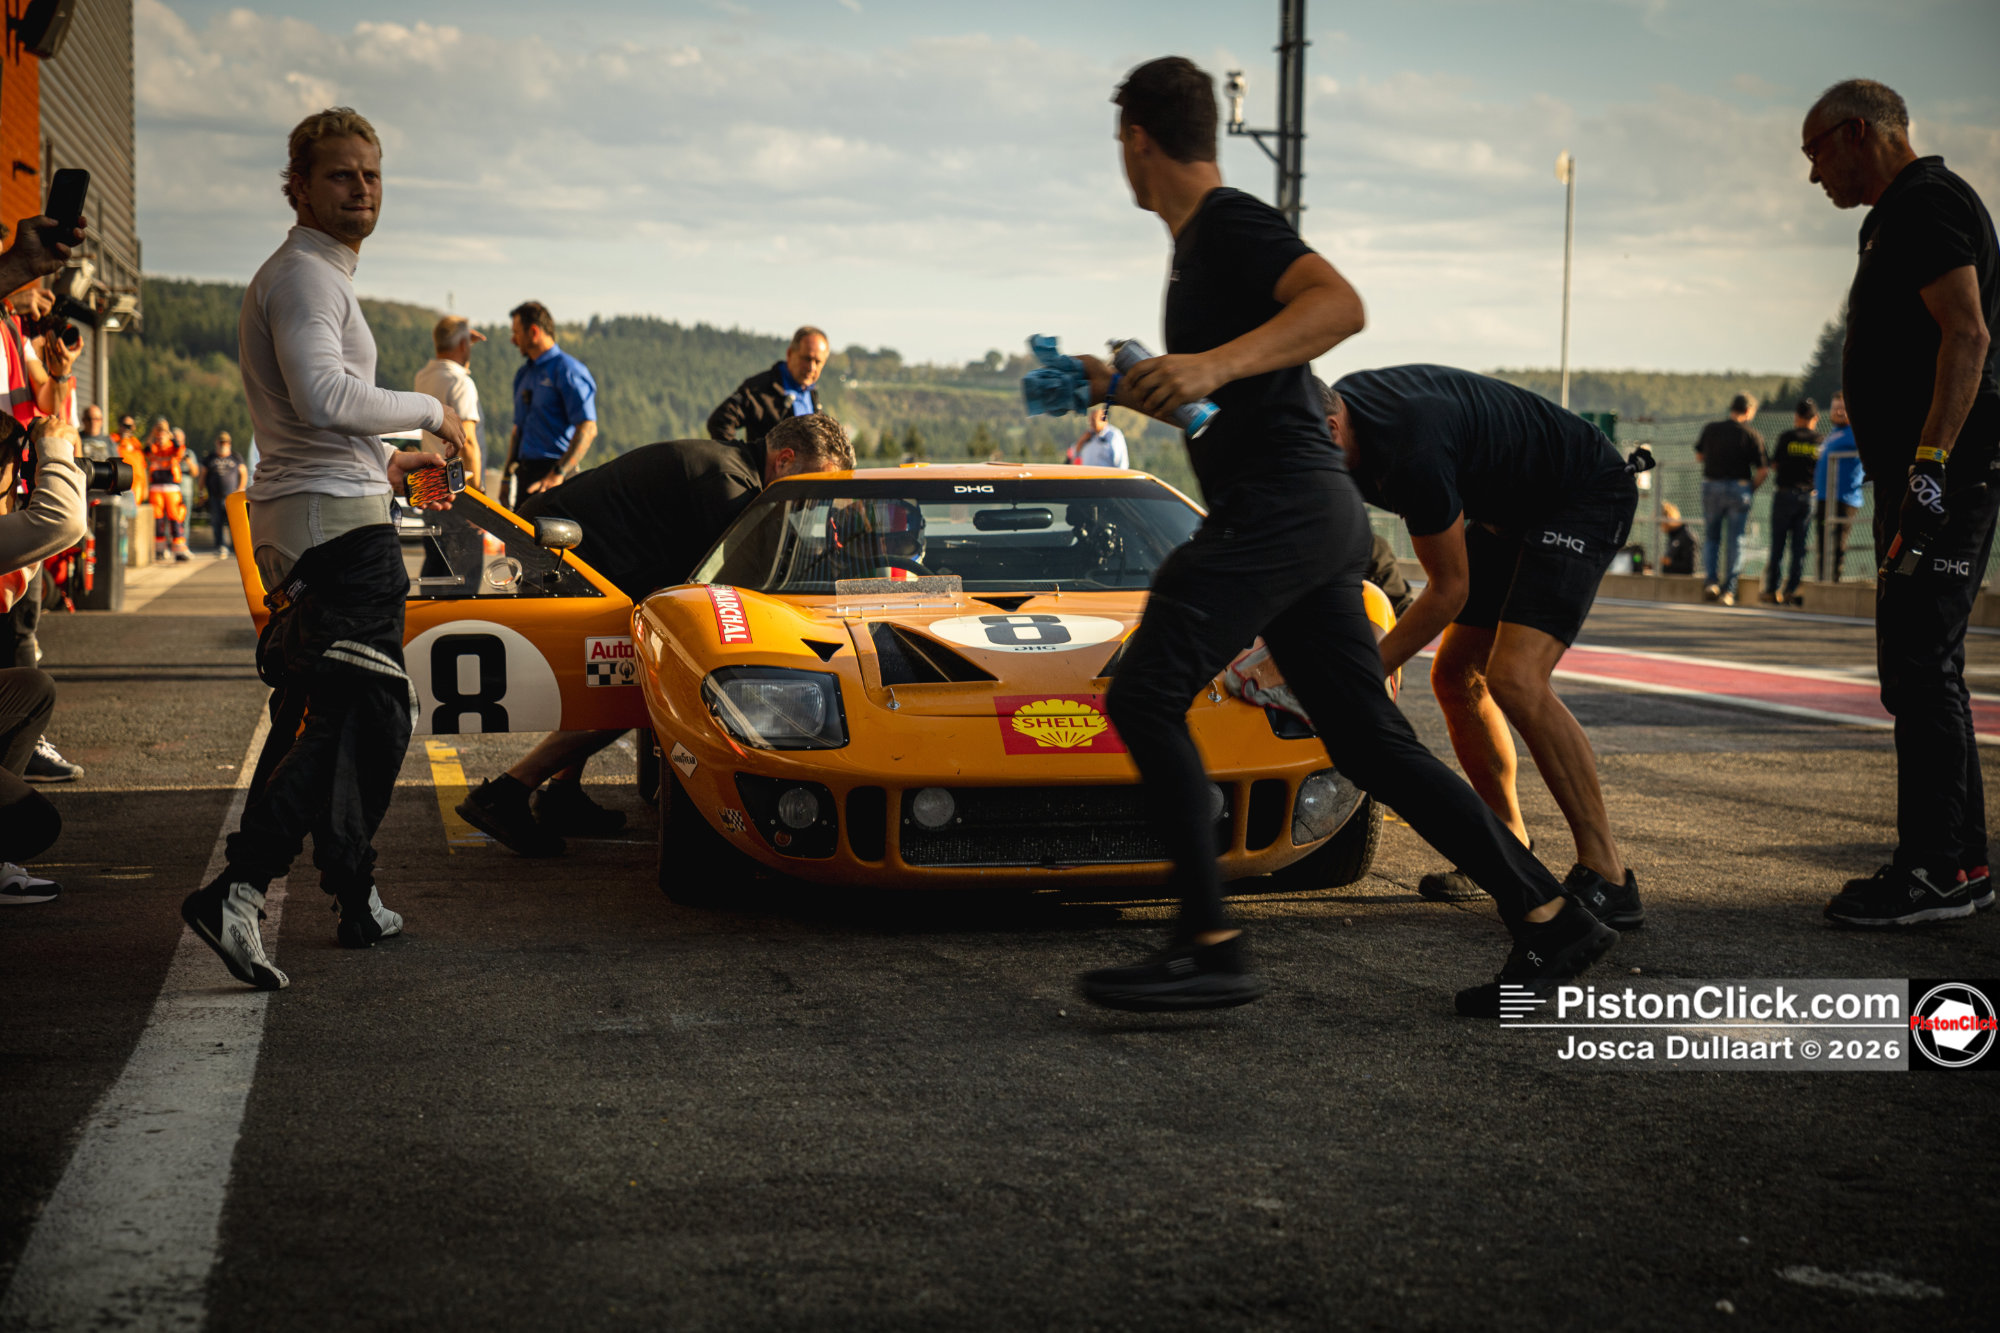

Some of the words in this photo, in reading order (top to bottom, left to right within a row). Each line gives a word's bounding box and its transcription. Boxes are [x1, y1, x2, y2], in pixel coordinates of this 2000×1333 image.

[953, 485, 994, 494] DHG
[1541, 530, 1586, 554] DHG
[1933, 558, 1970, 576] DHG
[711, 588, 747, 642] MARCHAL
[978, 614, 1072, 645] 8
[430, 633, 509, 734] 8
[1021, 716, 1098, 729] SHELL
